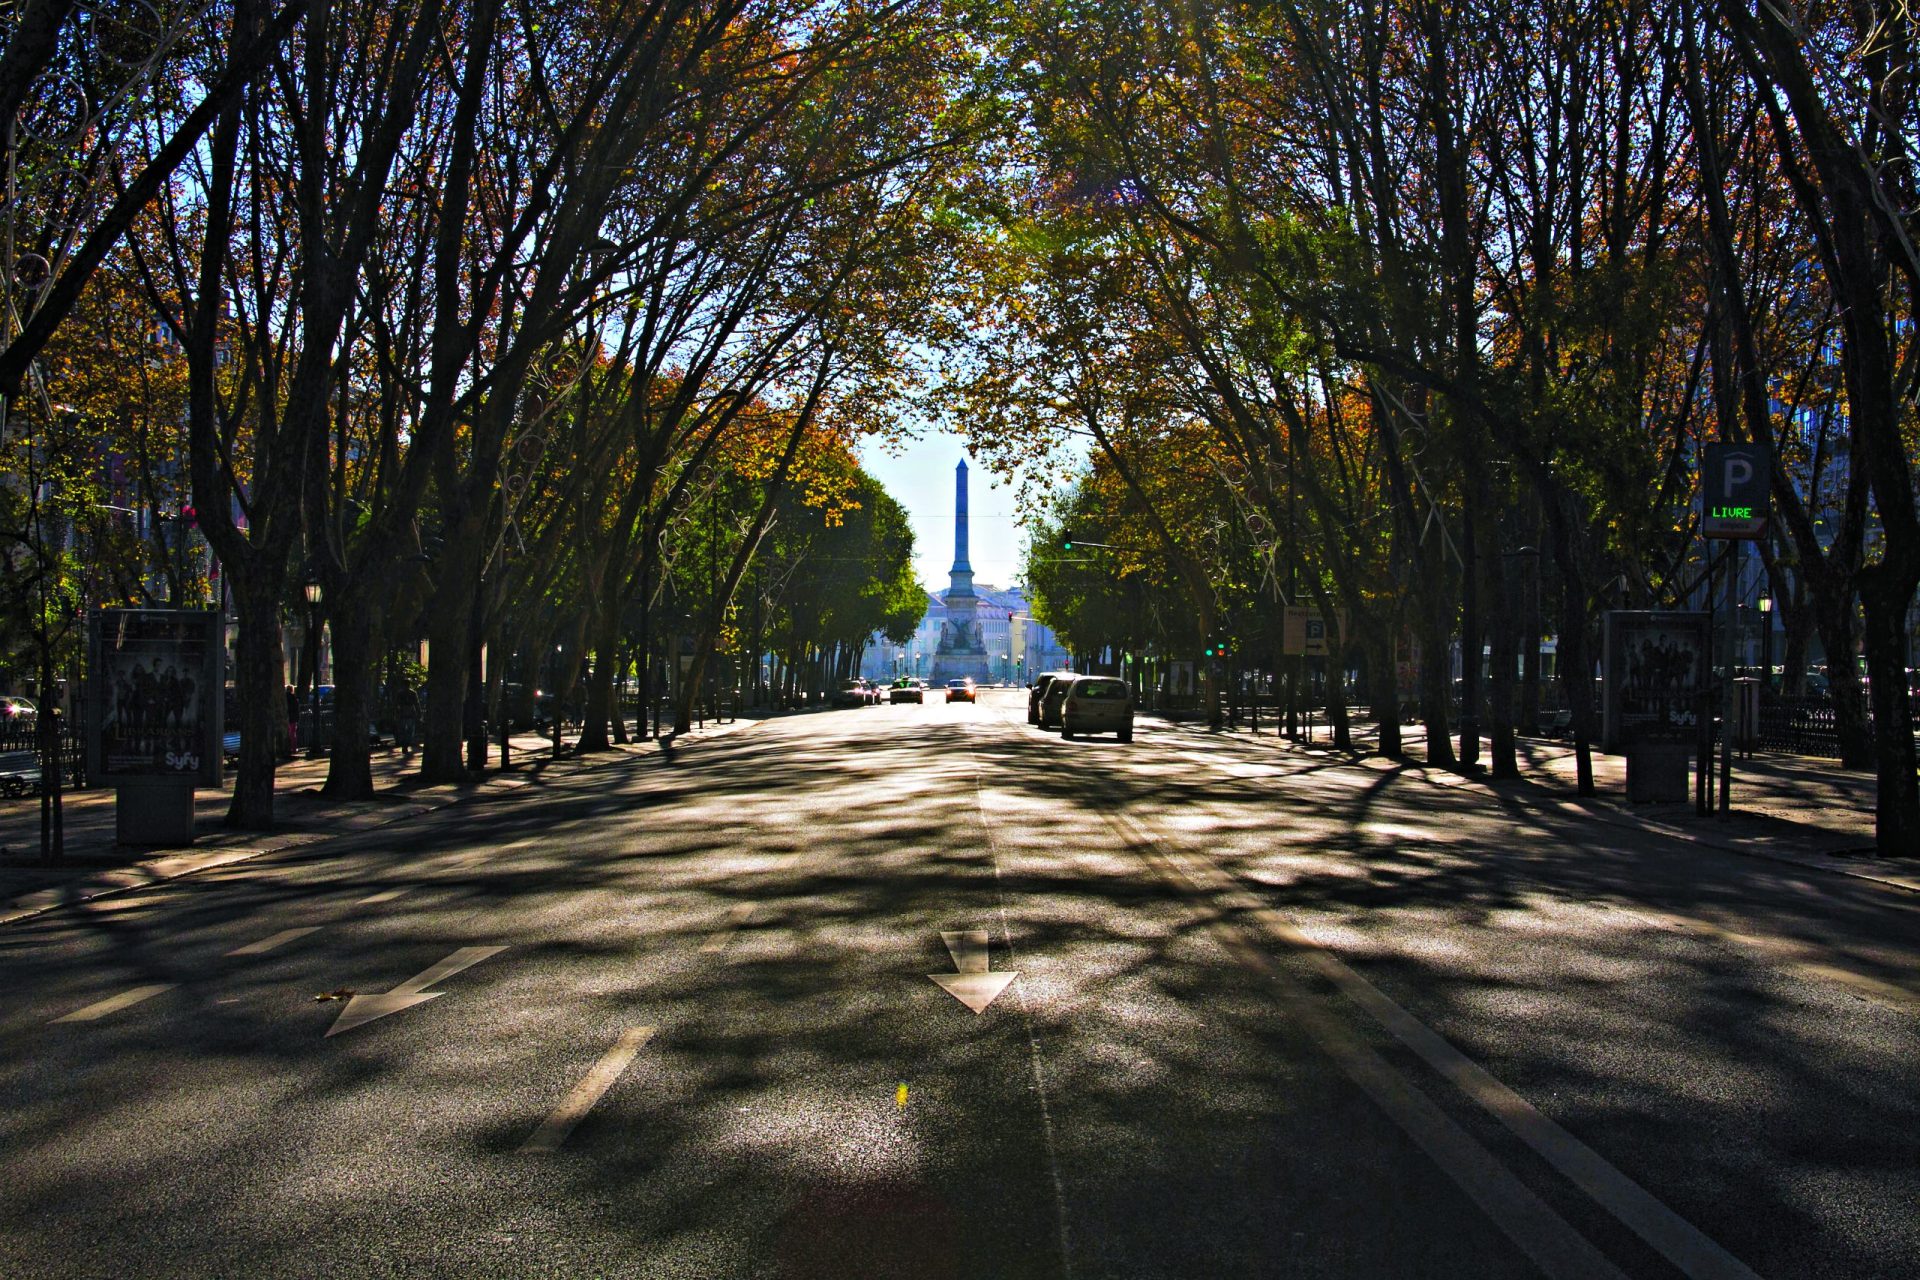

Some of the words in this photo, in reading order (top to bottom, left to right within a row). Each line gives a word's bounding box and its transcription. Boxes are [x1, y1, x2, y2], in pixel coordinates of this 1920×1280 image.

[1724, 459, 1753, 498] P
[1712, 506, 1753, 518] LIVRE
[1669, 710, 1697, 725] Syfy
[165, 751, 200, 771] Syfy
